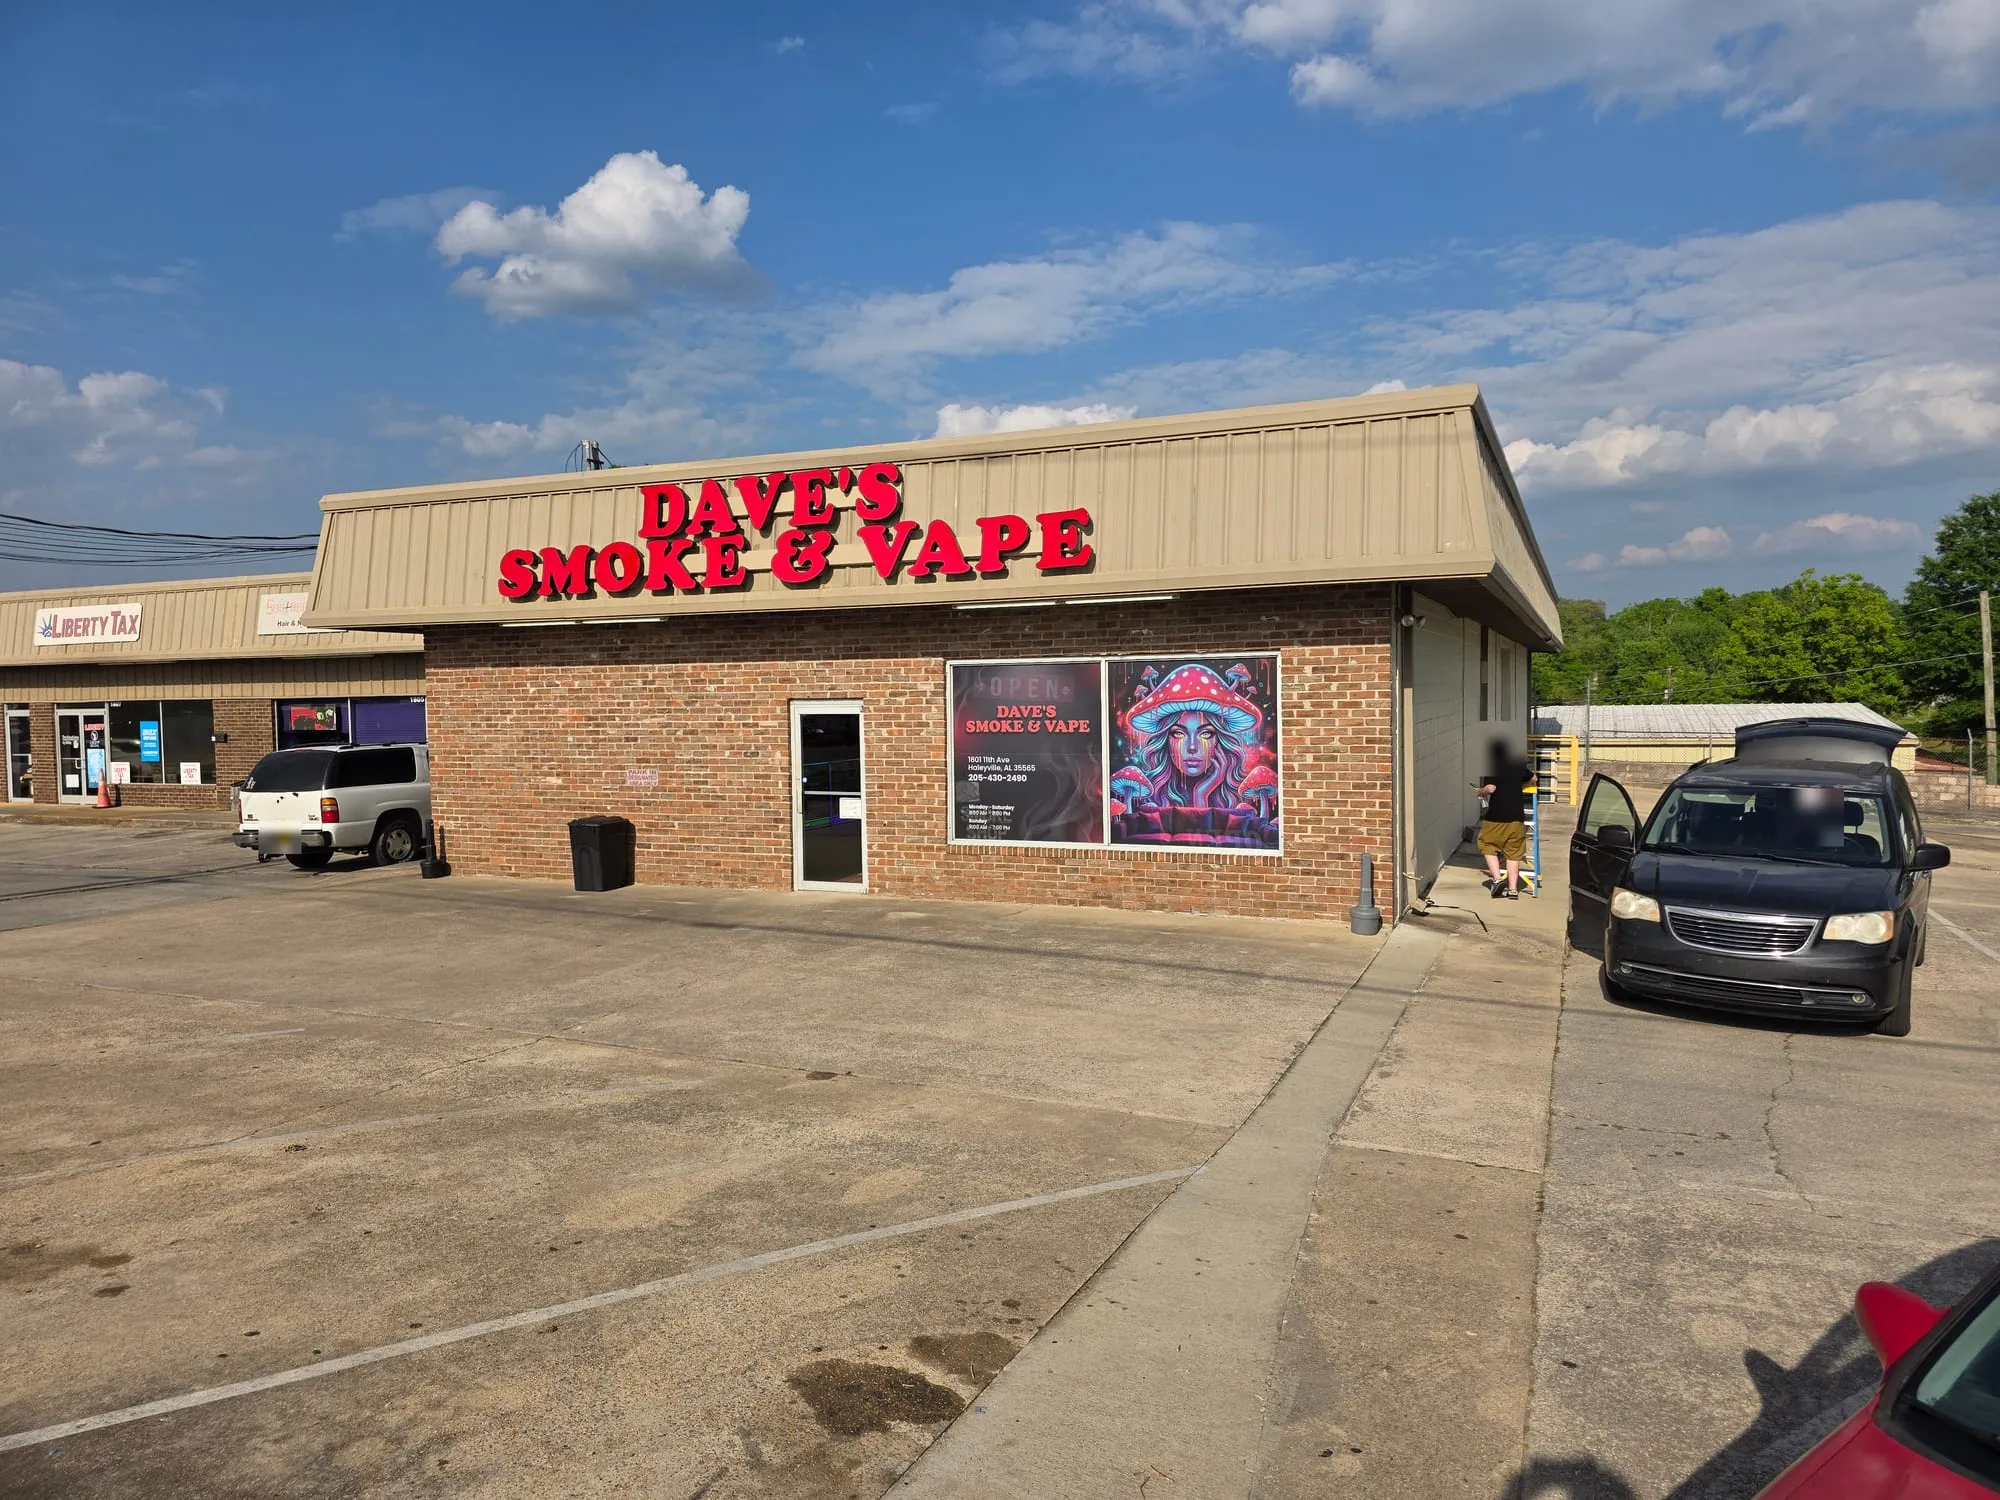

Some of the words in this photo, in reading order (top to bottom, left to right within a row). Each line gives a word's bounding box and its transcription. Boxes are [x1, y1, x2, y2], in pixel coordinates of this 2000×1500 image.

[638, 462, 900, 538] DAVE'S
[498, 534, 746, 598] SMOKE
[771, 529, 830, 583] &
[857, 508, 1092, 578] VAPE
[52, 614, 109, 638] LIBERTY
[111, 610, 139, 635] TAX
[990, 677, 1058, 698] OPEN
[997, 705, 1056, 718] DAVE'S
[966, 720, 1024, 733] SMOKE
[1027, 720, 1041, 733] &
[1044, 720, 1090, 733] VAPE
[968, 774, 1027, 782] 205-430-2490
